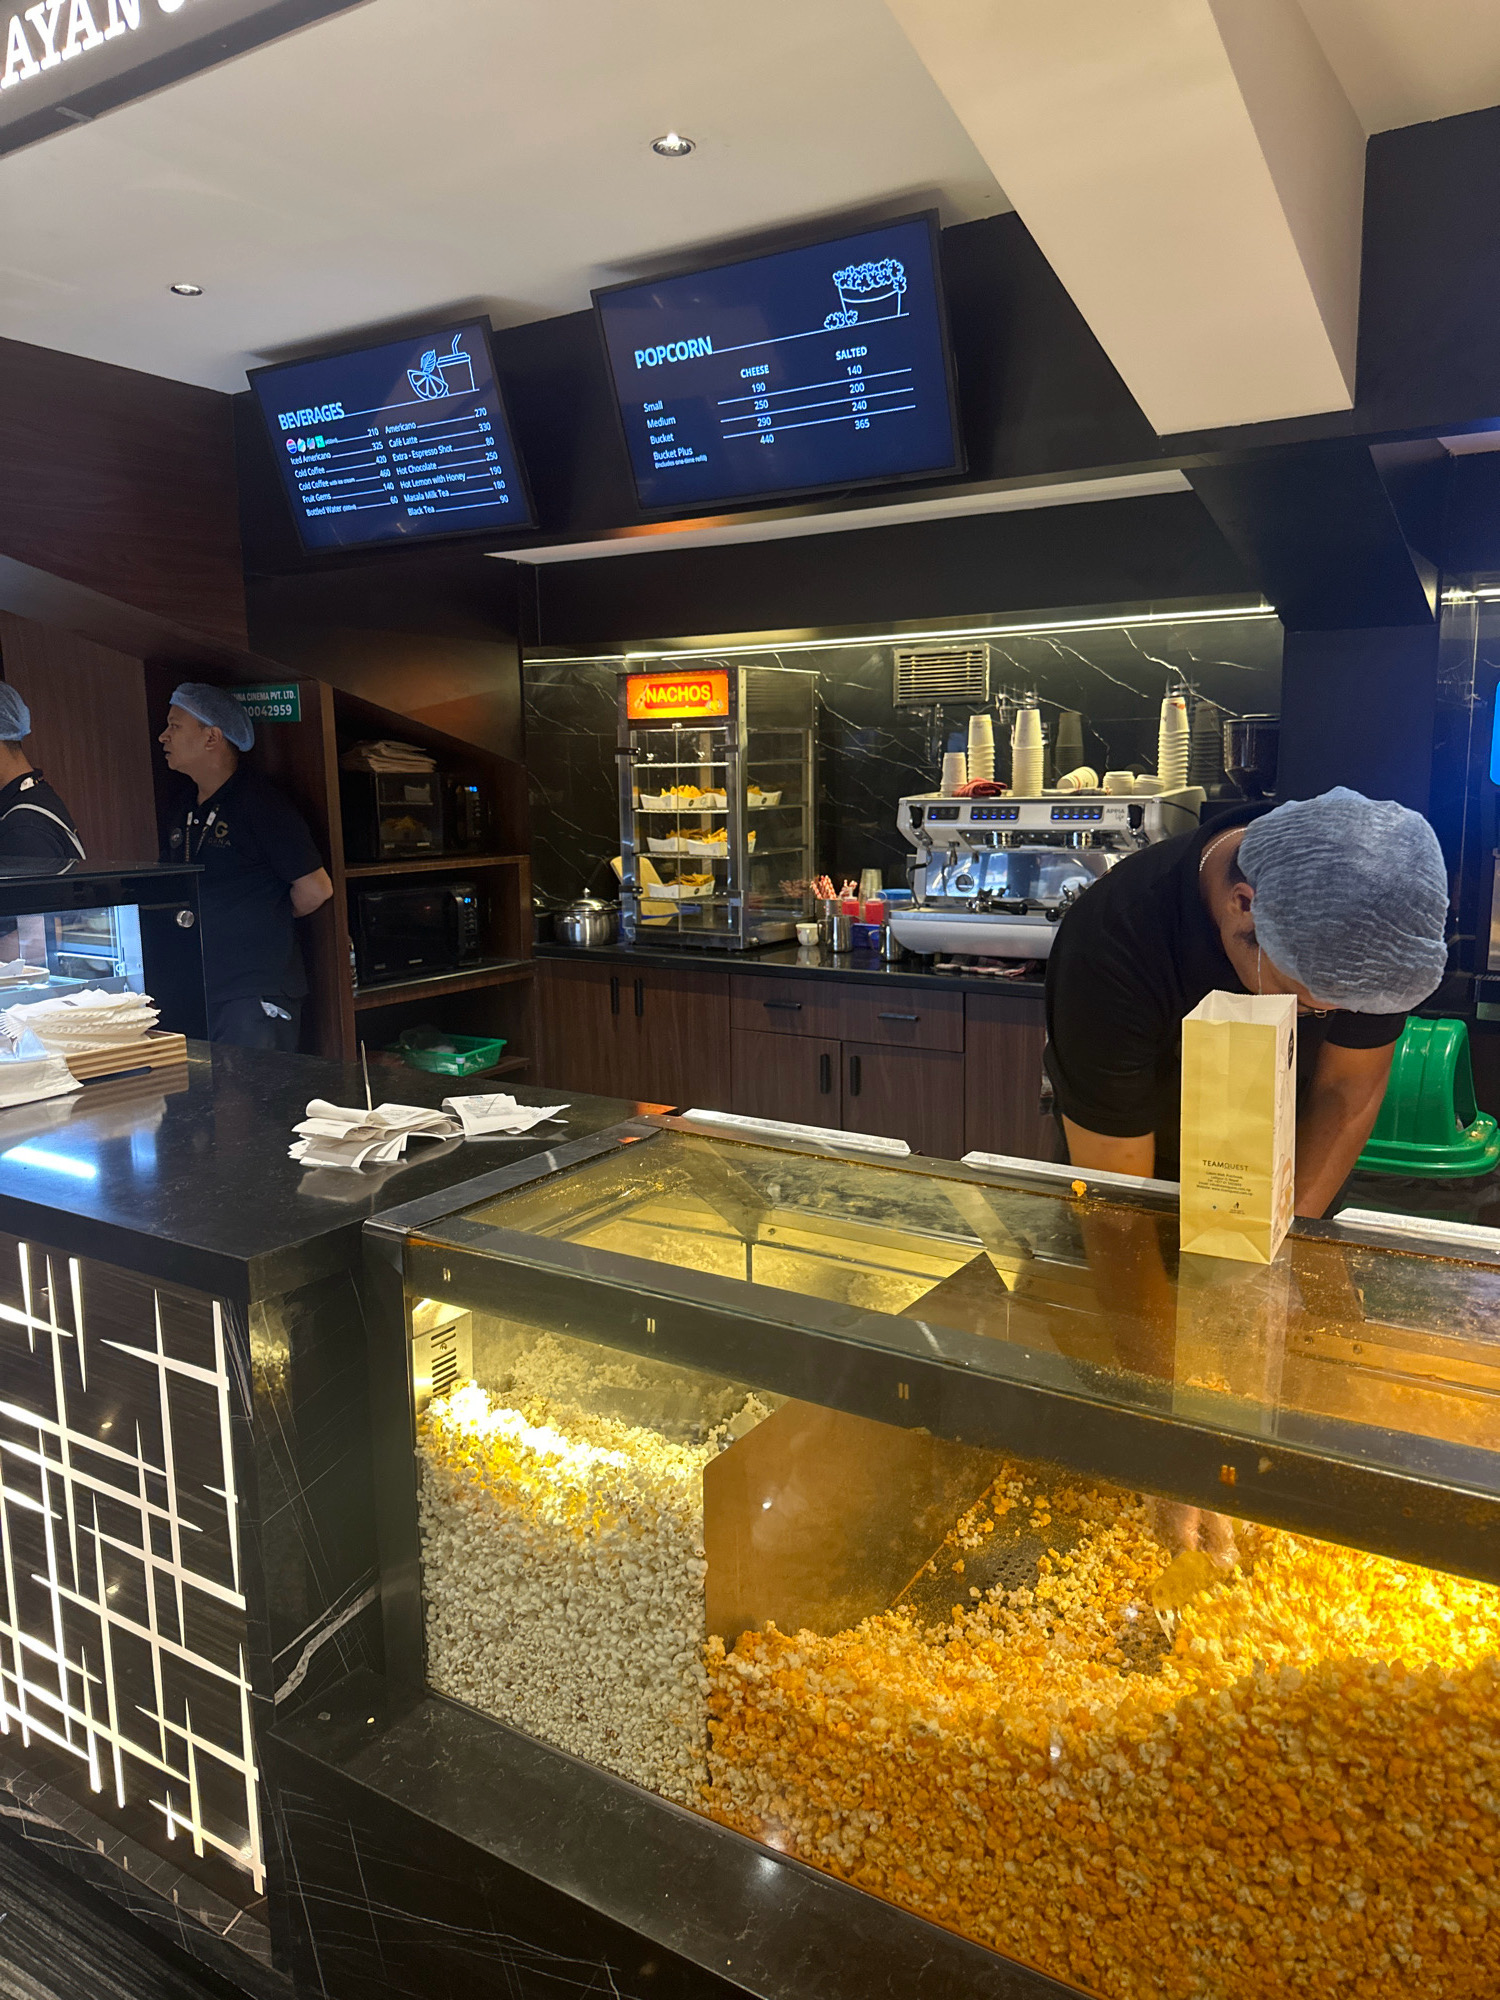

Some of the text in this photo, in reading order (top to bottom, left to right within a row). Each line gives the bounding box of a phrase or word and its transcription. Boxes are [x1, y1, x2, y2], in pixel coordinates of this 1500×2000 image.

[635, 336, 712, 369] POPCORN
[836, 346, 868, 360] SALTED
[740, 364, 769, 378] CHEESE
[847, 365, 862, 376] 140
[644, 382, 766, 412] Small 190
[850, 382, 865, 394] 200
[278, 402, 344, 430] BEVERAGES
[647, 400, 768, 428] Medium 250
[852, 400, 867, 412] 240
[385, 407, 487, 434] Americano 270
[650, 416, 771, 444] Bucket 290
[854, 418, 870, 430] 365
[367, 428, 379, 437] 210
[389, 422, 491, 448] Café Latte 330
[290, 441, 383, 465] Iced Americano 325
[392, 452, 408, 462] Extra
[411, 448, 438, 459] Espresso
[438, 444, 453, 454] Shot
[485, 437, 494, 446] 80
[653, 434, 774, 461] Bucket Plus 440
[295, 455, 387, 478] Cold Coffee 420
[396, 452, 498, 476] Hot Chocolate 250
[299, 482, 311, 491] Cold
[312, 479, 329, 488] Coffee
[380, 469, 391, 477] 460
[400, 466, 502, 489] Hot Lemon with Honey 190
[302, 482, 394, 503] Fruit Gems 140
[404, 480, 505, 502] Masala Milk Tea 180
[306, 506, 325, 516] Bottled
[326, 505, 341, 514] Water
[390, 496, 398, 504] 60
[408, 495, 508, 516] Black Tea 90
[247, 692, 269, 701] CINEMA
[270, 691, 283, 700] PVT.
[284, 690, 296, 699] LTD.
[646, 685, 711, 703] NACHOS
[1202, 1160, 1249, 1171] TEAMQUEST
